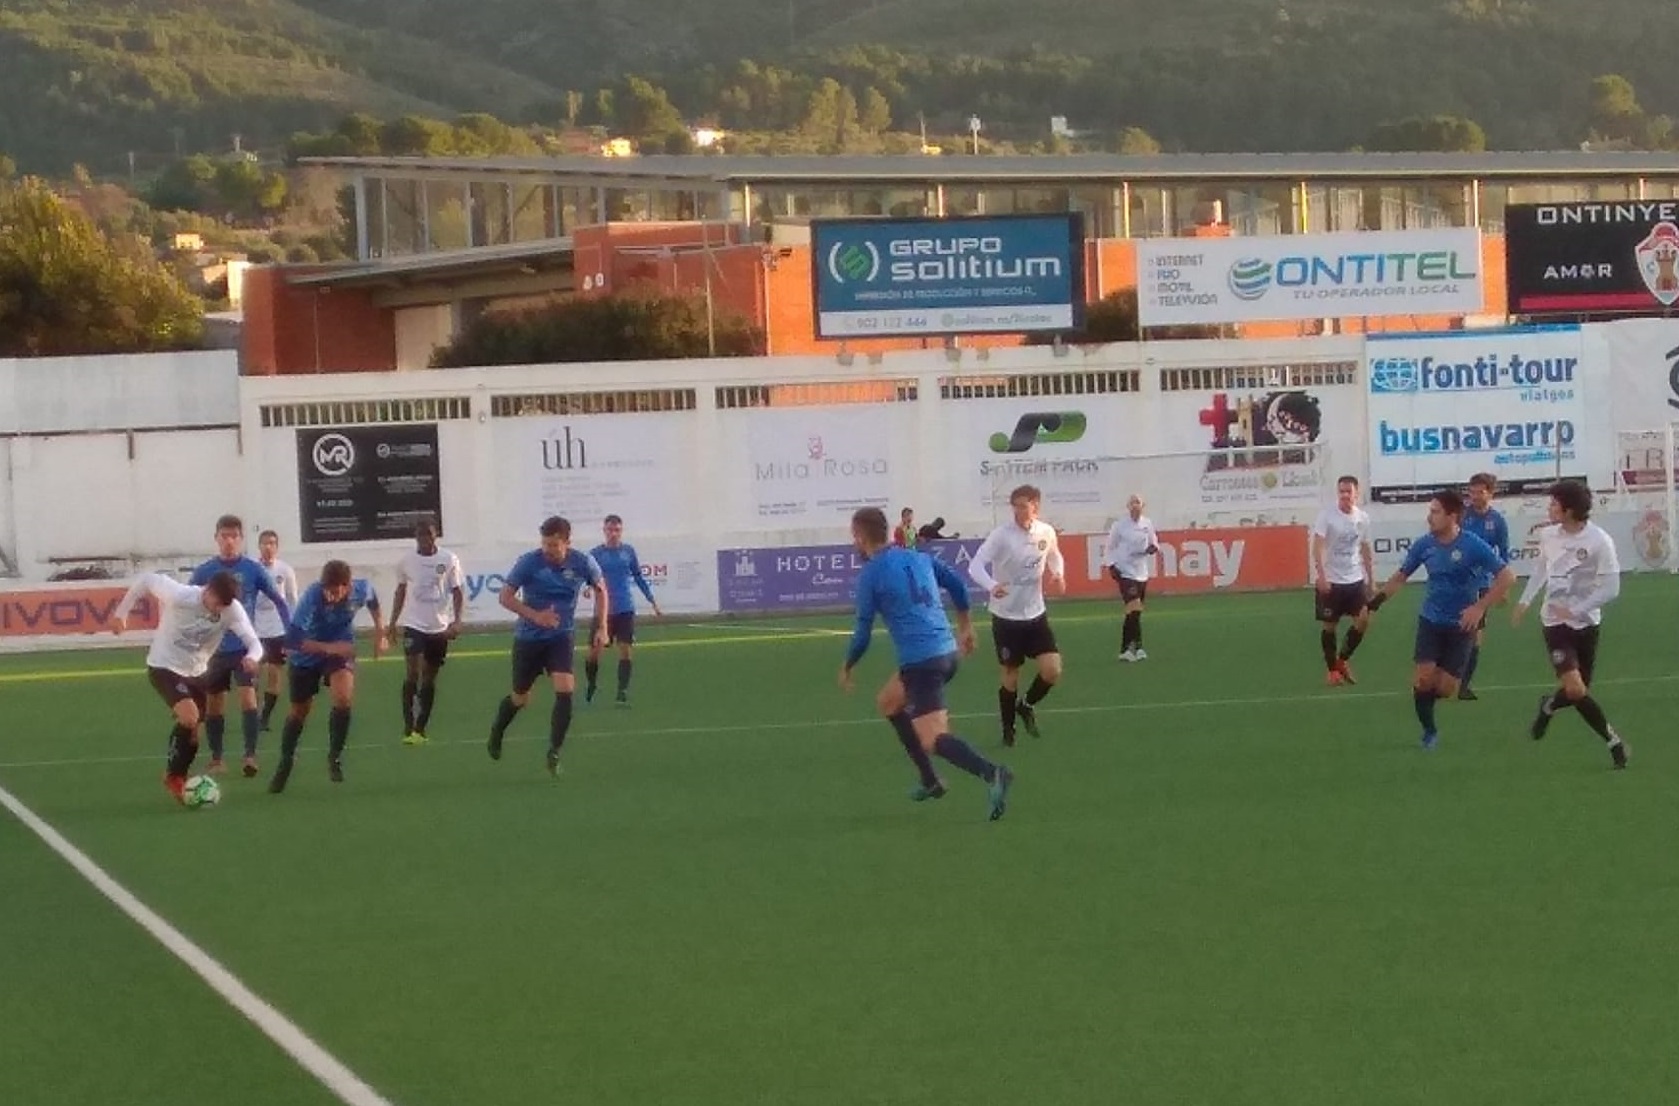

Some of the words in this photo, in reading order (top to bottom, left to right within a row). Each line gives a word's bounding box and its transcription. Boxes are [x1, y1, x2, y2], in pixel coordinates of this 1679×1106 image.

[1537, 202, 1677, 225] ONTINYE
[889, 236, 1002, 256] GRUPO
[890, 255, 1061, 282] solitium
[1275, 251, 1477, 287] ONTITEL
[1317, 286, 1406, 299] OPERADOR
[1410, 284, 1460, 295] LOCAL
[1421, 353, 1578, 389] fonti-tour
[1380, 419, 1575, 453] busnavarro
[777, 553, 863, 573] HOTEL
